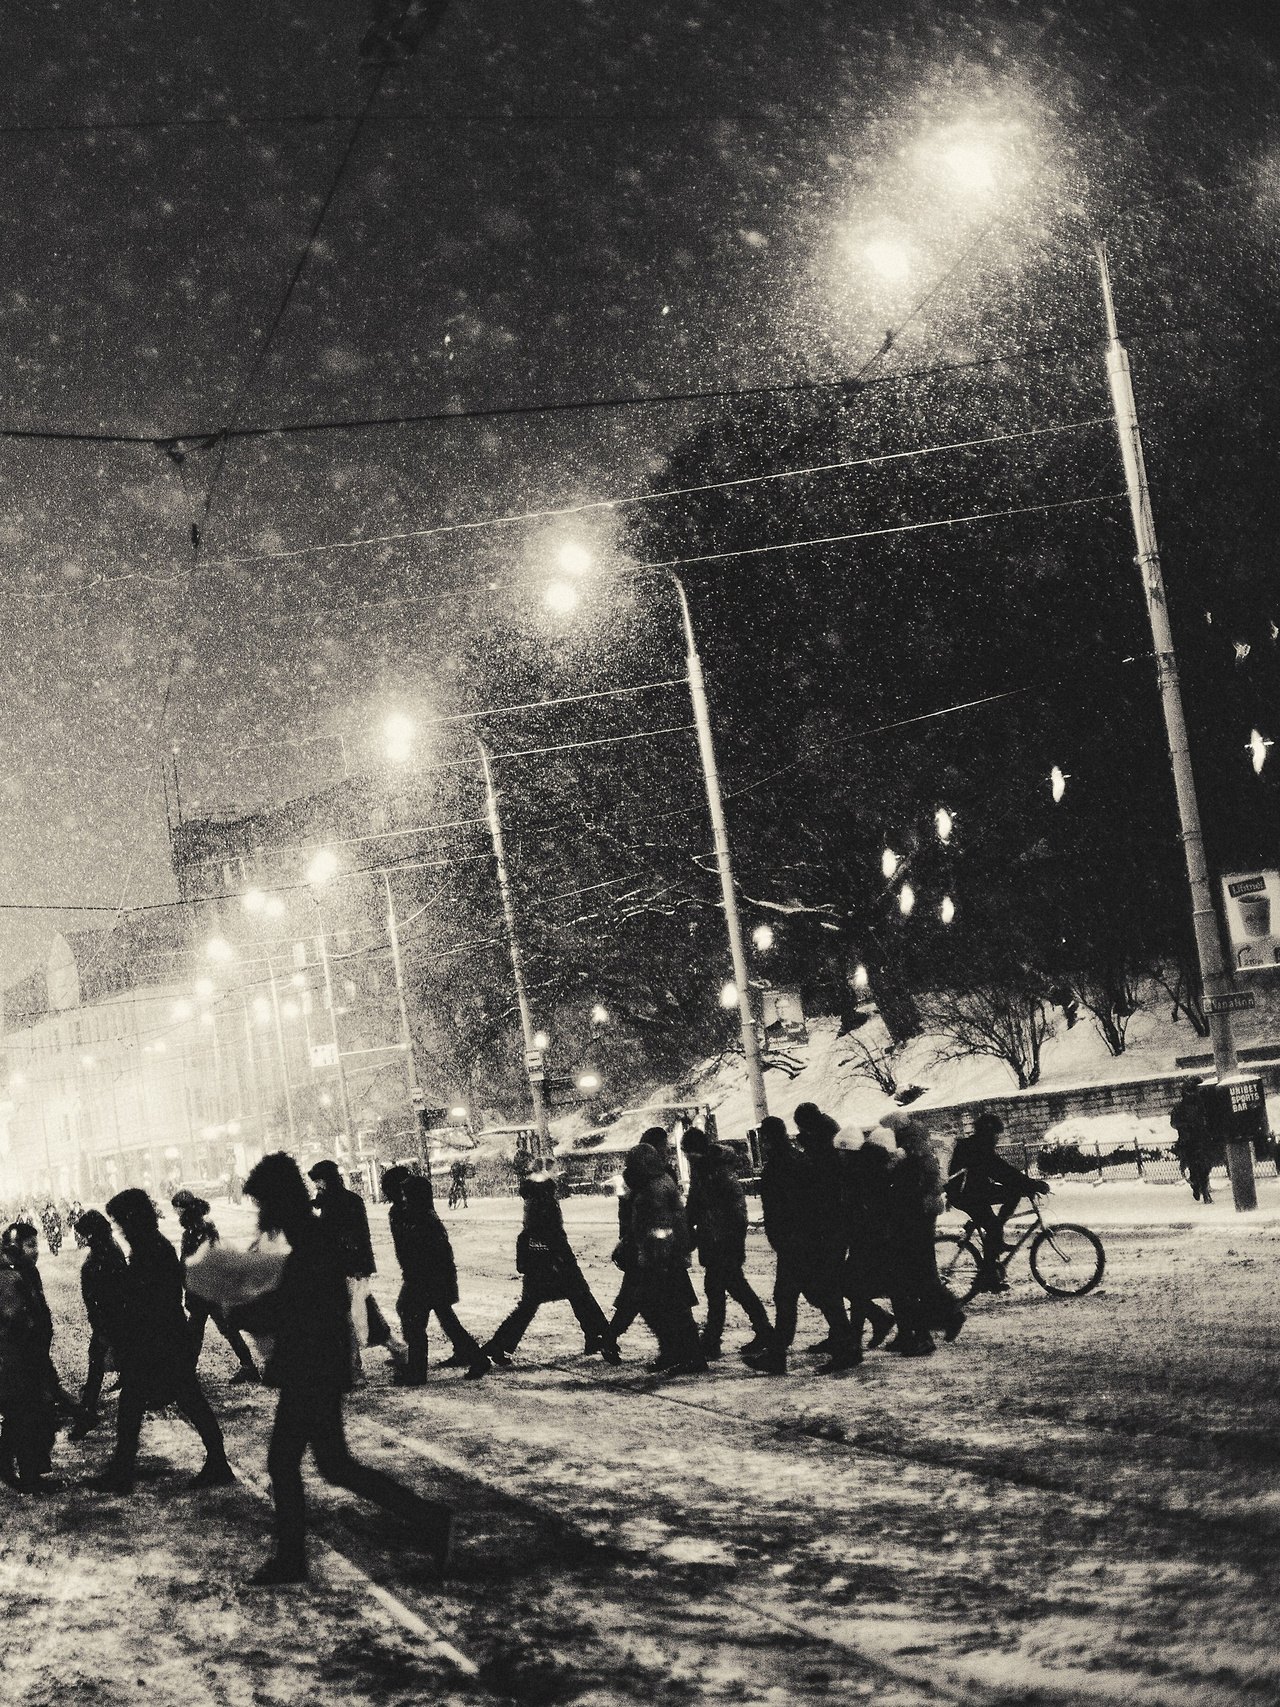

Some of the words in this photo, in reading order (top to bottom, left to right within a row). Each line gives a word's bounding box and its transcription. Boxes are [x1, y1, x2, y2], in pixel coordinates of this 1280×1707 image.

[1230, 1084, 1257, 1096] UNIBET
[1231, 1092, 1260, 1104] SPORTS
[1233, 1102, 1248, 1113] BAR
